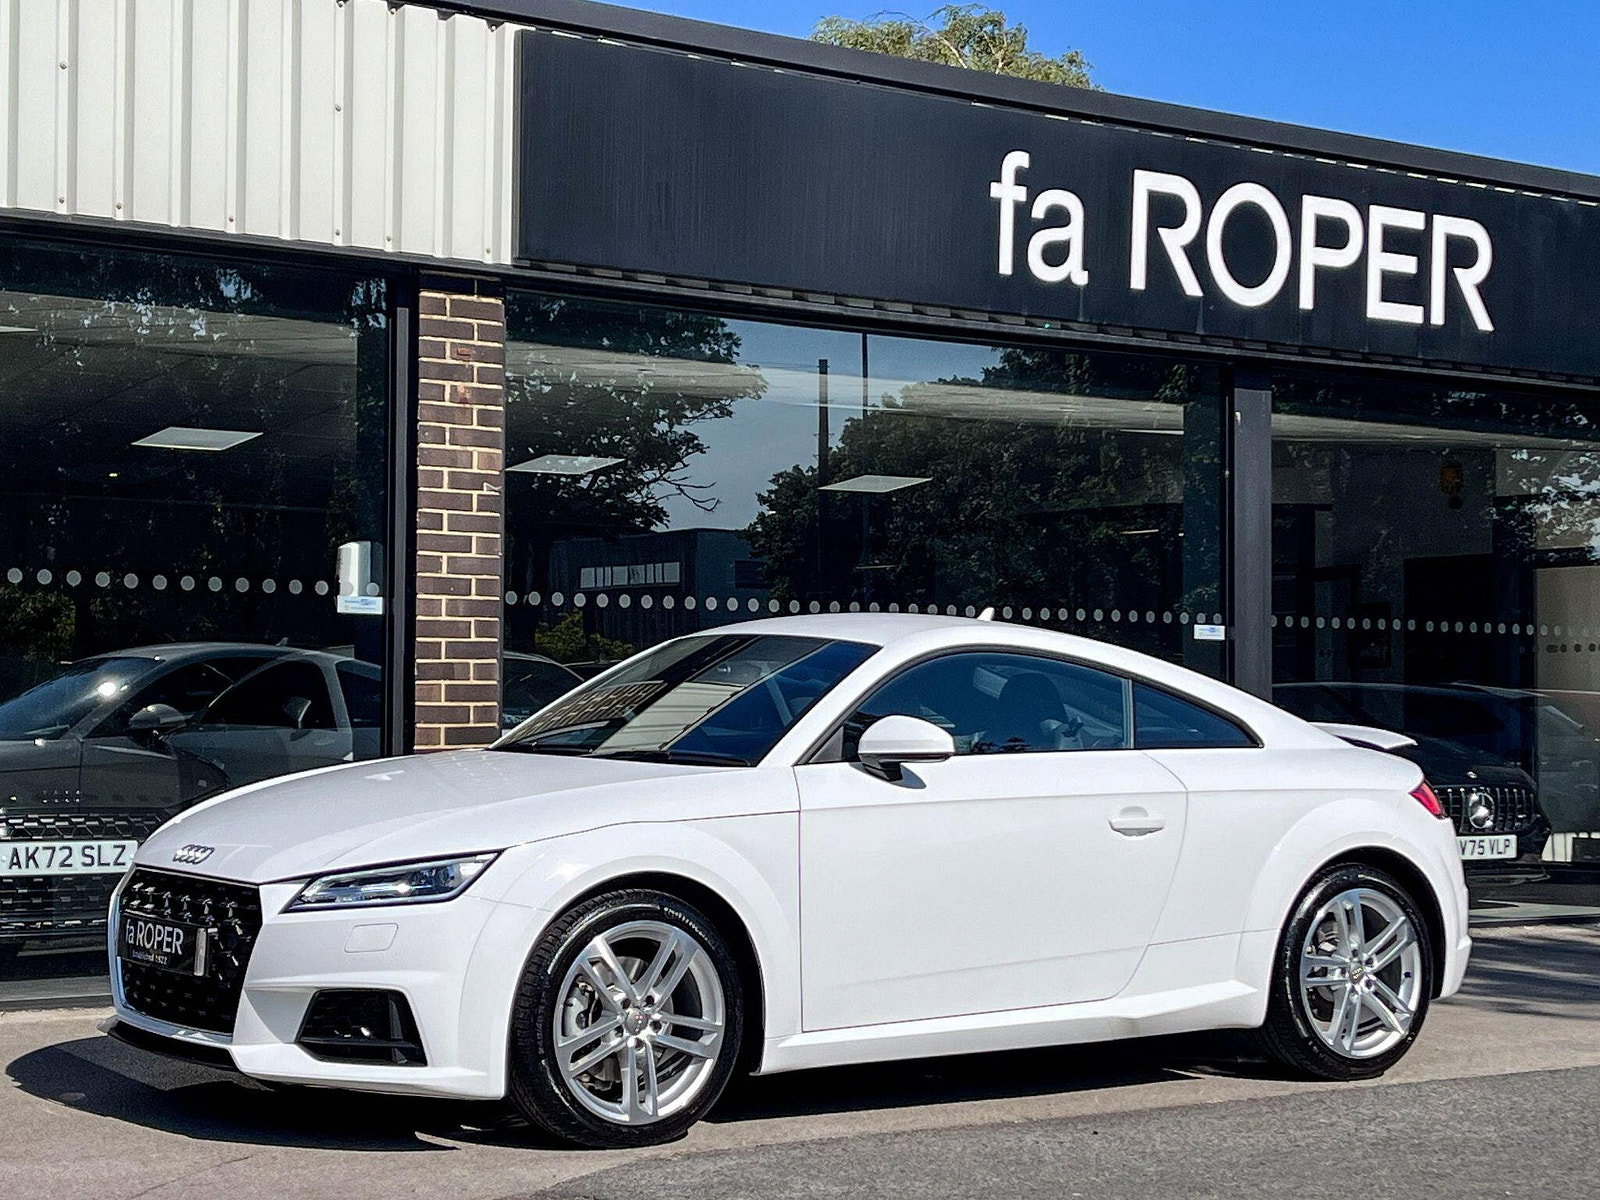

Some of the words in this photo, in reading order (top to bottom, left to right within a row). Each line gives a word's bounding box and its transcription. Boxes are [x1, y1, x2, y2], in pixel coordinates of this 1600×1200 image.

[990, 150, 1088, 286] fa
[1130, 169, 1494, 332] ROPER
[8, 845, 73, 869] AK72
[81, 844, 126, 867] SLZ
[1458, 839, 1485, 856] V75
[1489, 838, 1511, 855] VLP
[126, 918, 135, 945] fa
[136, 921, 184, 955] ROPER
